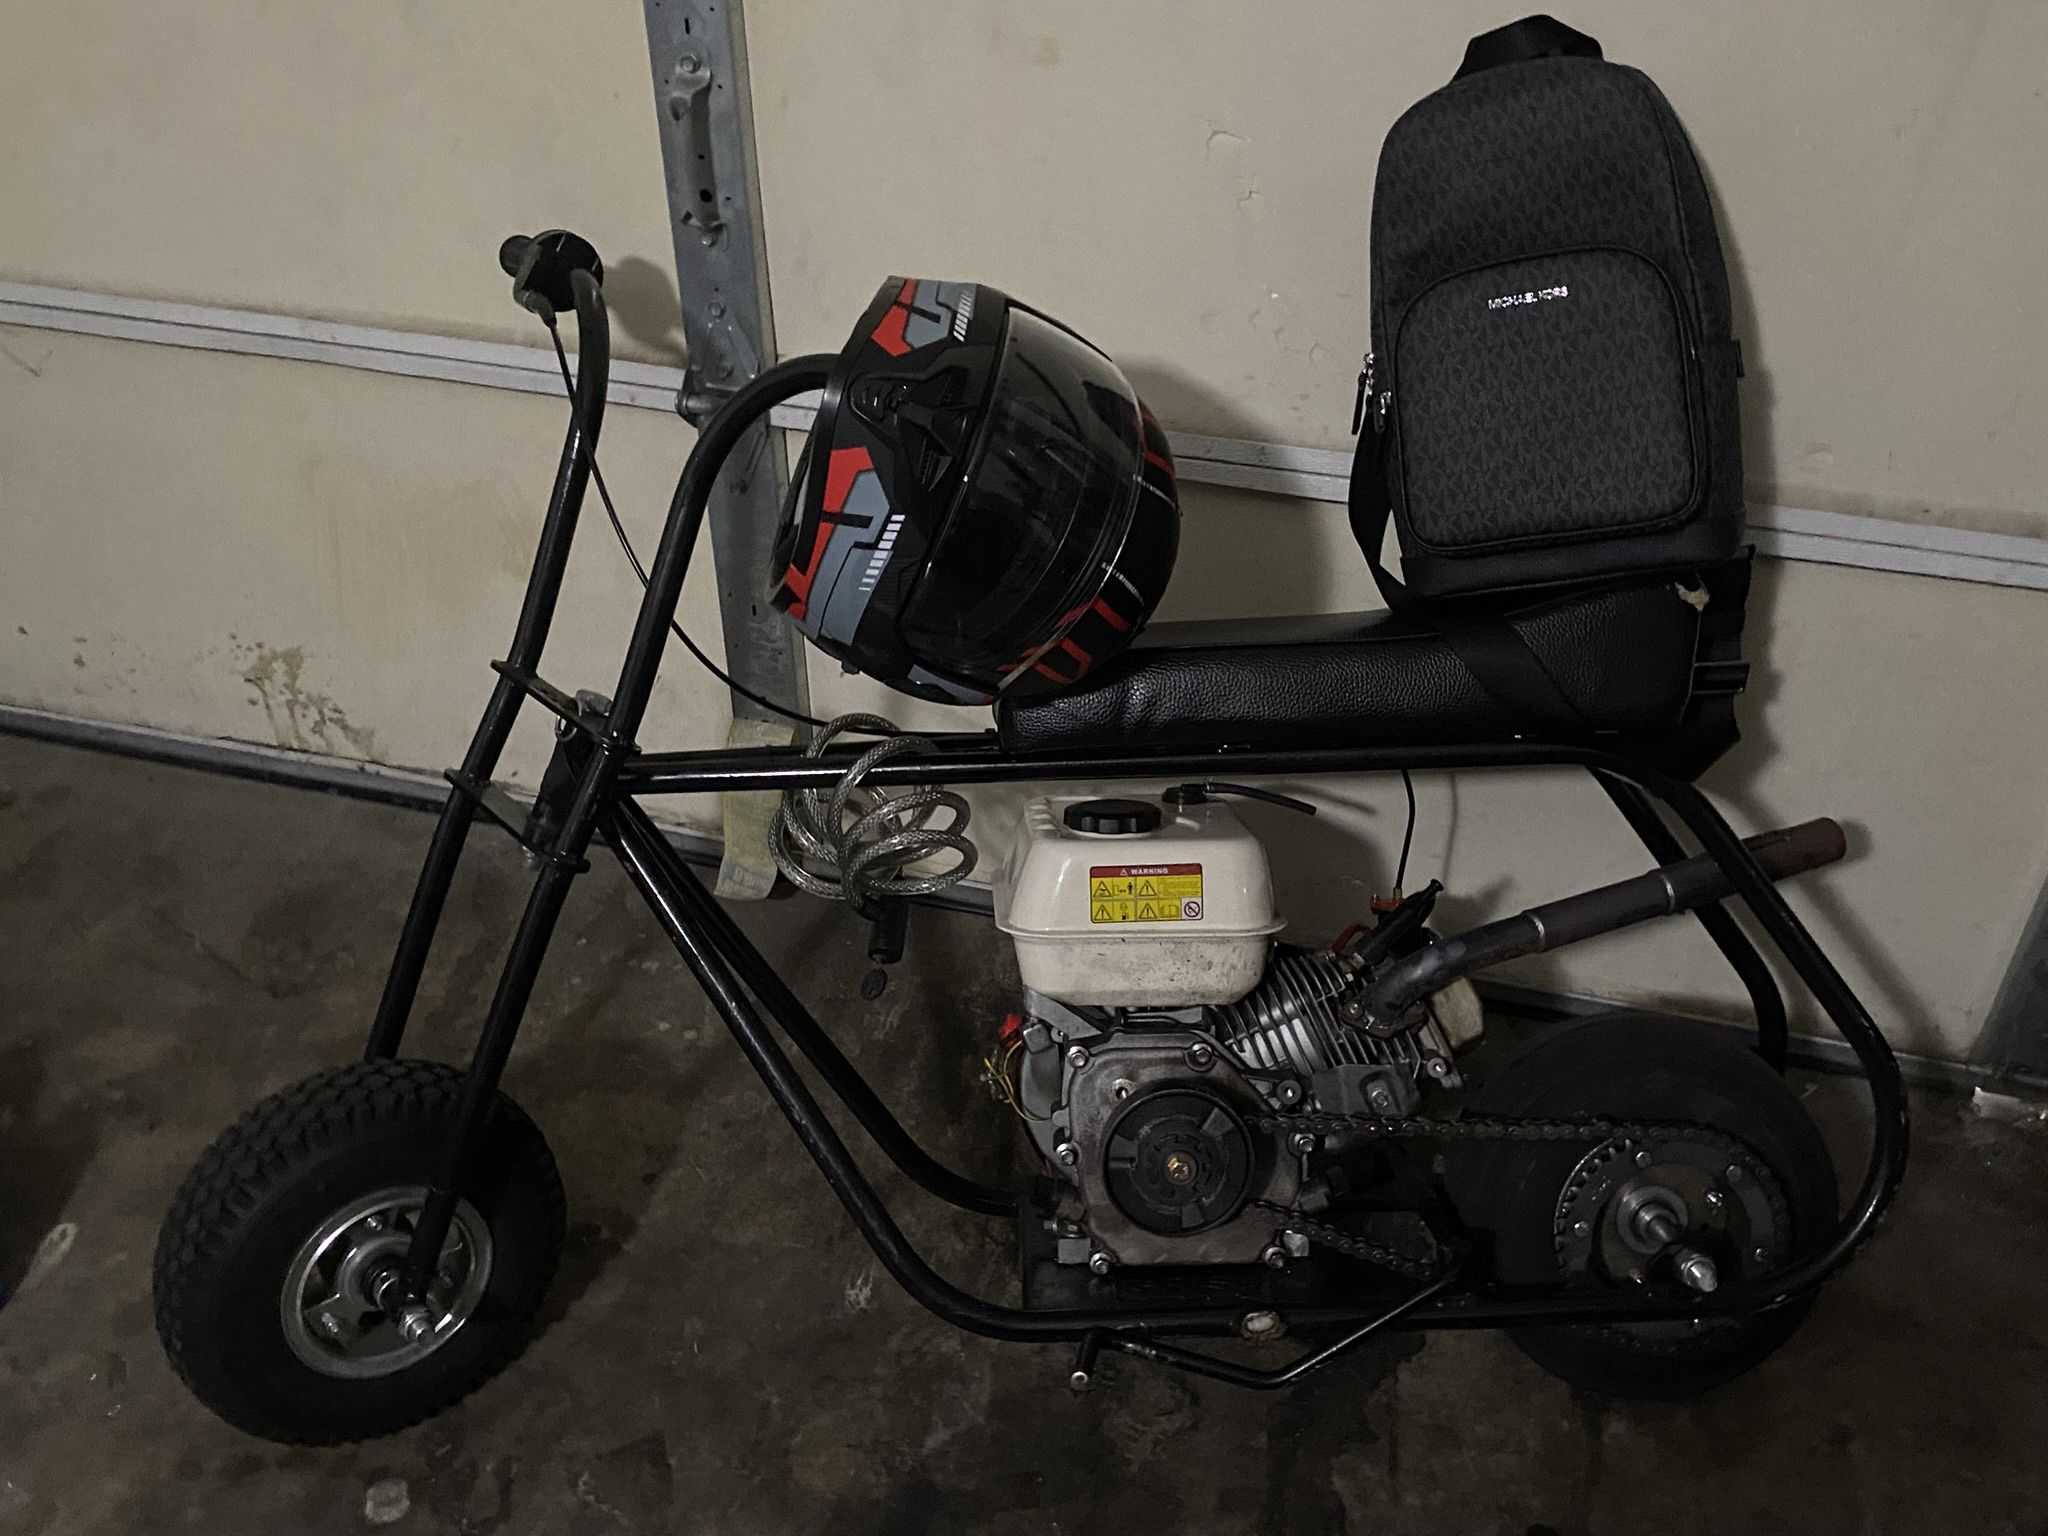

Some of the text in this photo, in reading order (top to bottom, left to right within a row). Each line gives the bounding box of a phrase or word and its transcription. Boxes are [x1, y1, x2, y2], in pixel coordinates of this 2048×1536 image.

[1487, 286, 1569, 310] MICHAEL KORS
[1130, 867, 1169, 876] WARNING
